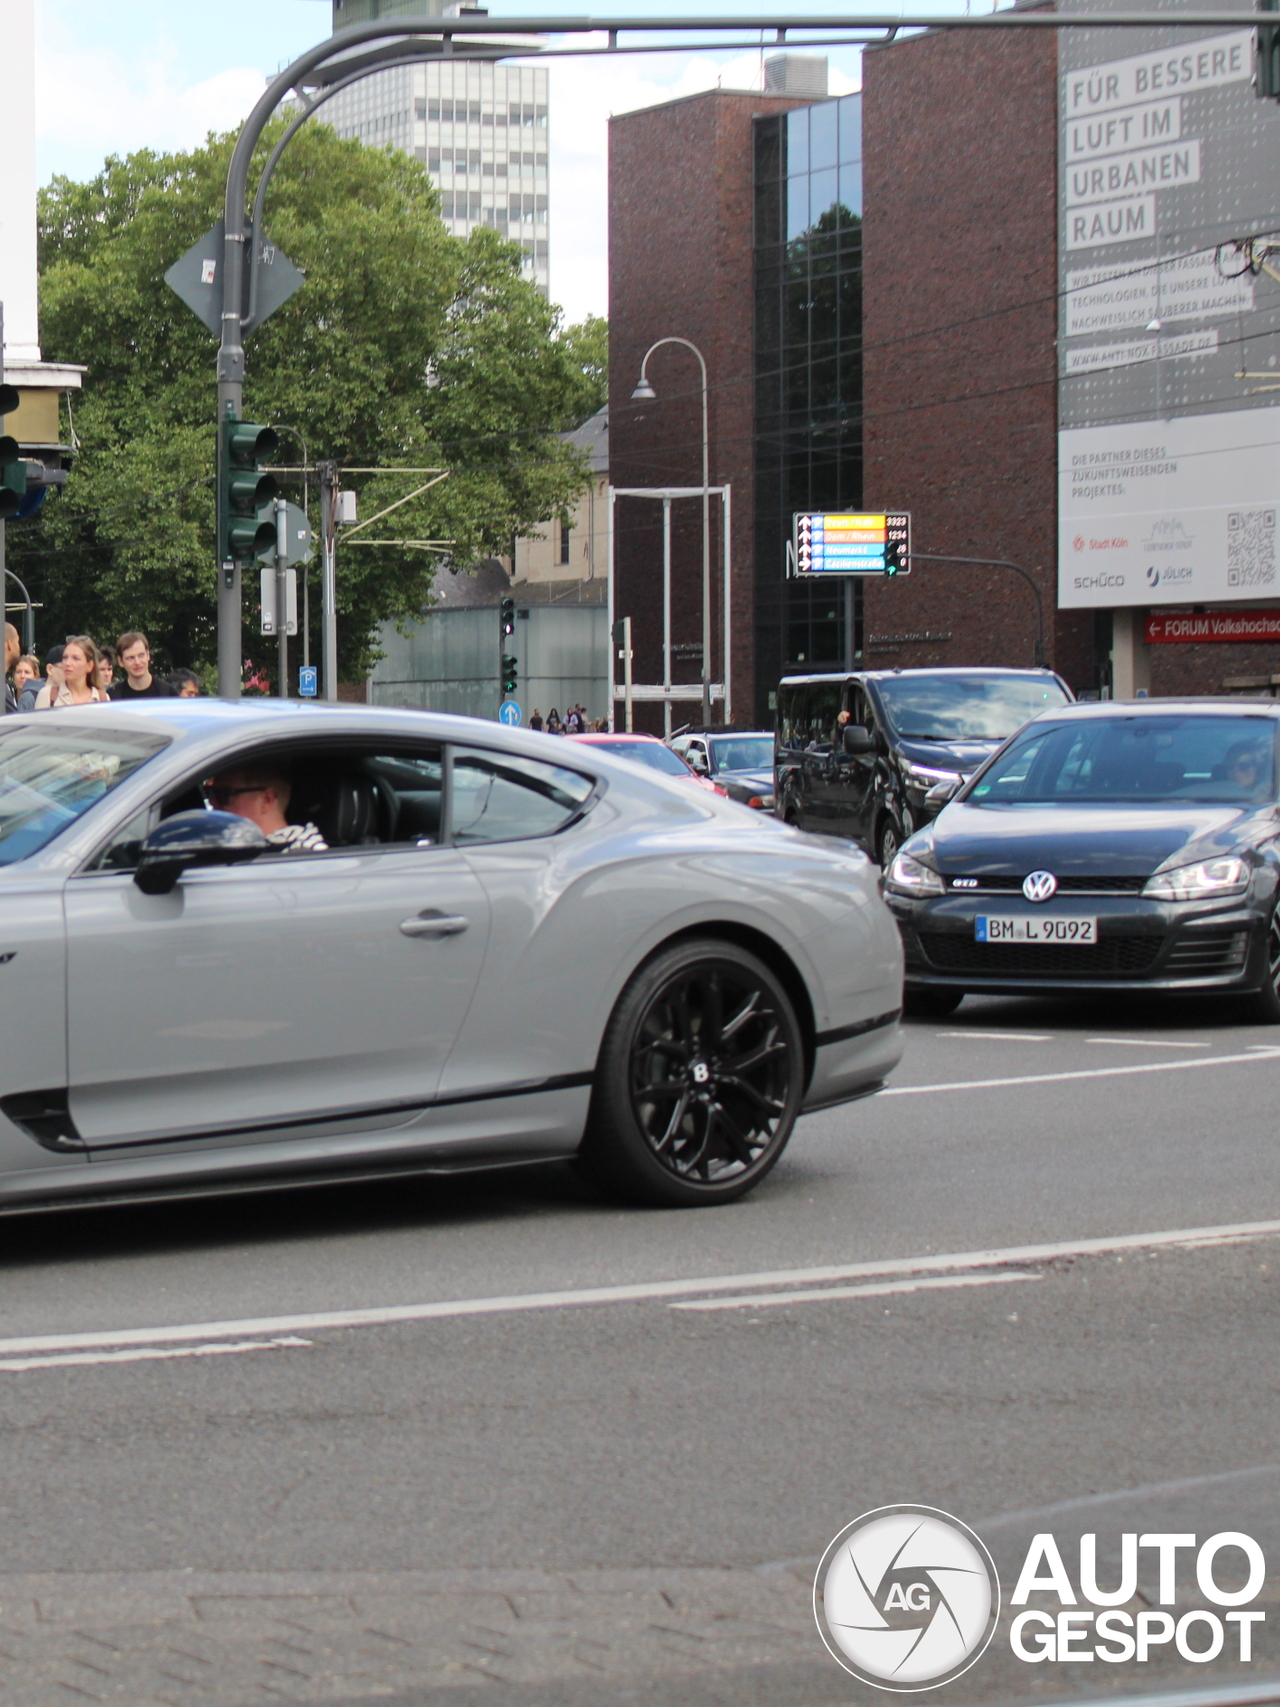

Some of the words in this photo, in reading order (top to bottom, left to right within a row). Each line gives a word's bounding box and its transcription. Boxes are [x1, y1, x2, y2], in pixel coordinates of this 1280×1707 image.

[1073, 71, 1119, 108] FÜR
[1135, 45, 1242, 95] BESSERE
[1073, 117, 1133, 154] LUFT
[1142, 108, 1170, 139] IM
[1073, 150, 1190, 198] URBANEN
[1074, 205, 1145, 242] RAUM
[1071, 275, 1089, 289] WIR
[1169, 277, 1209, 293] UNSERE
[1071, 307, 1145, 331] NACHWEISLICH
[1148, 300, 1198, 321] SAUBERER
[1072, 454, 1087, 467] DIE
[1089, 449, 1132, 465] PARTNER
[1133, 446, 1167, 460] DIESES
[1072, 461, 1178, 482] ZUKUNFTSWEISENDEN
[888, 530, 907, 540] 1234
[826, 545, 867, 555] Neumarkt
[1074, 571, 1125, 589] SCHÜCO
[1162, 565, 1193, 580] JÜLICH
[1165, 619, 1209, 637] FORUM
[305, 673, 312, 685] P
[952, 878, 978, 888] GTD
[989, 919, 1014, 939] BM
[1026, 920, 1038, 939] L
[1043, 921, 1092, 940] 9092
[693, 1063, 709, 1083] B
